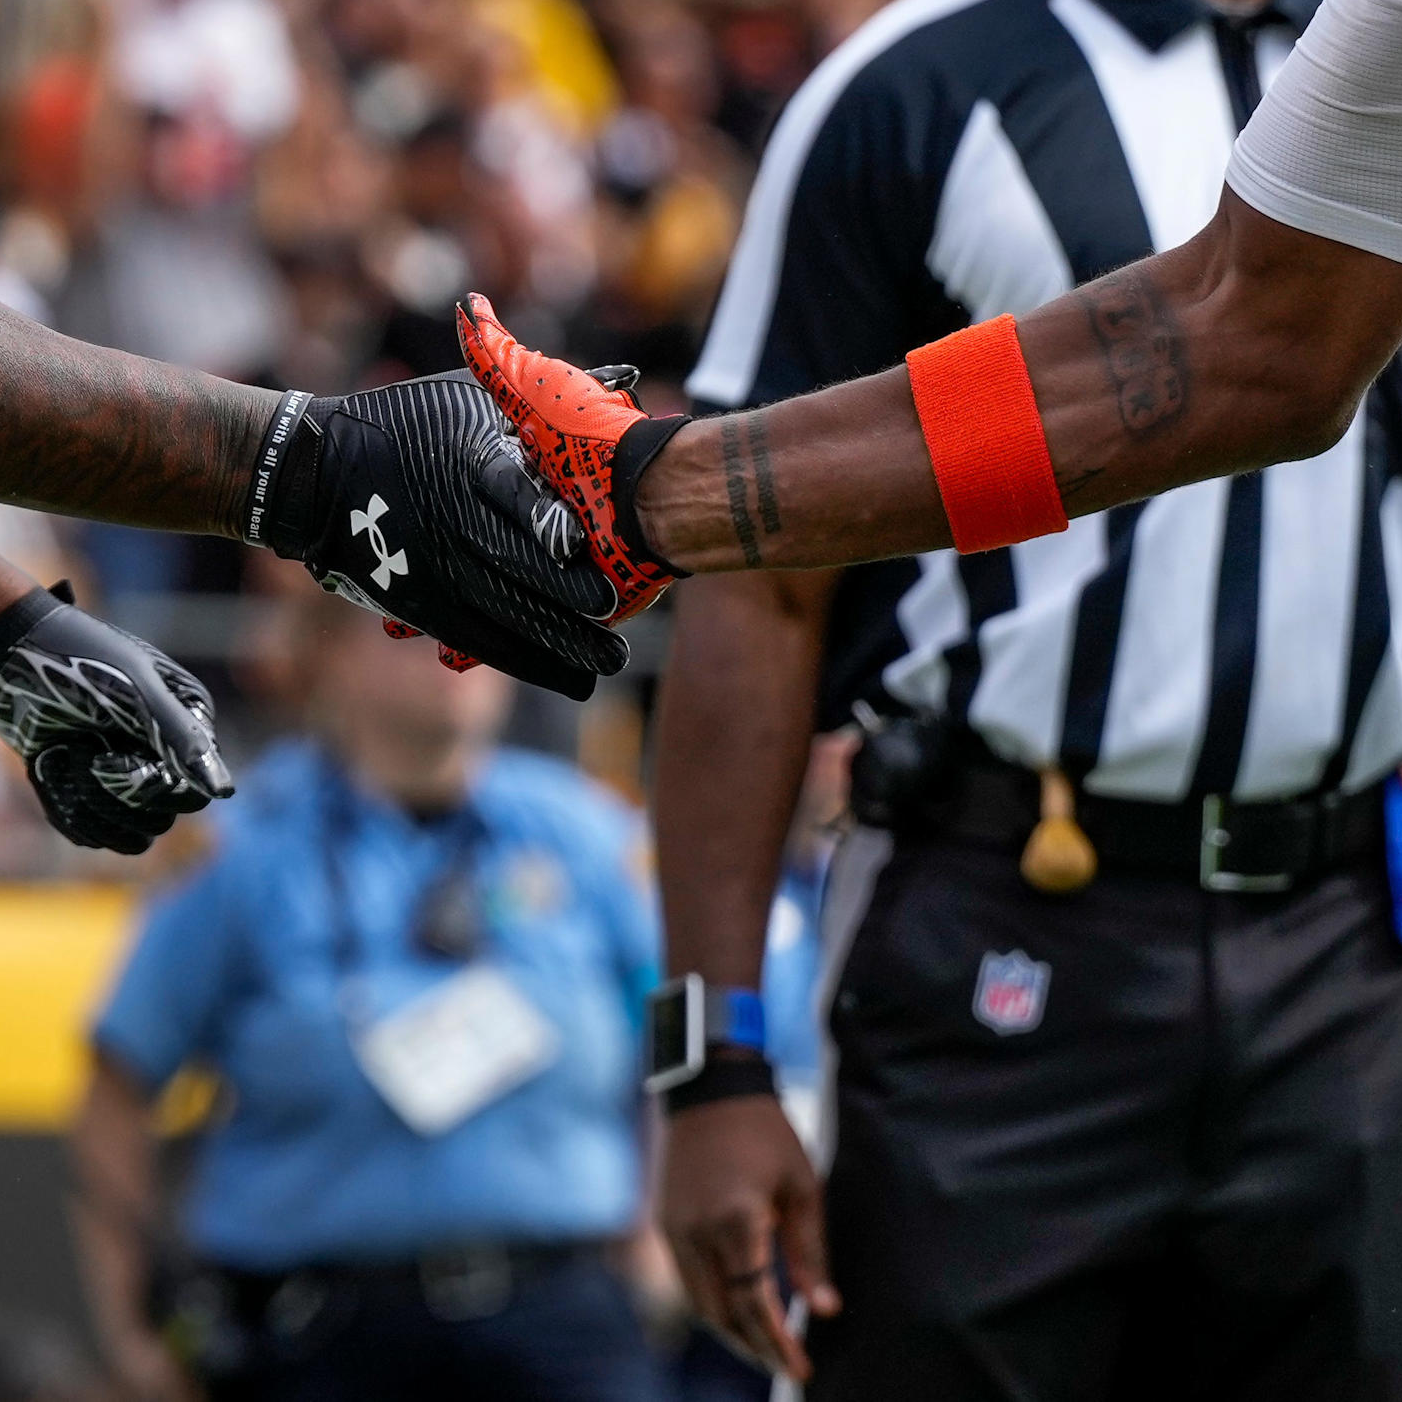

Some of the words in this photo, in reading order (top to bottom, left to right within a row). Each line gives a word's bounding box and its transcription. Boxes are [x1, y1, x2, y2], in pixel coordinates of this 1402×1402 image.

[272, 417, 292, 444] with
[264, 448, 278, 467] all
[255, 469, 271, 503] your
